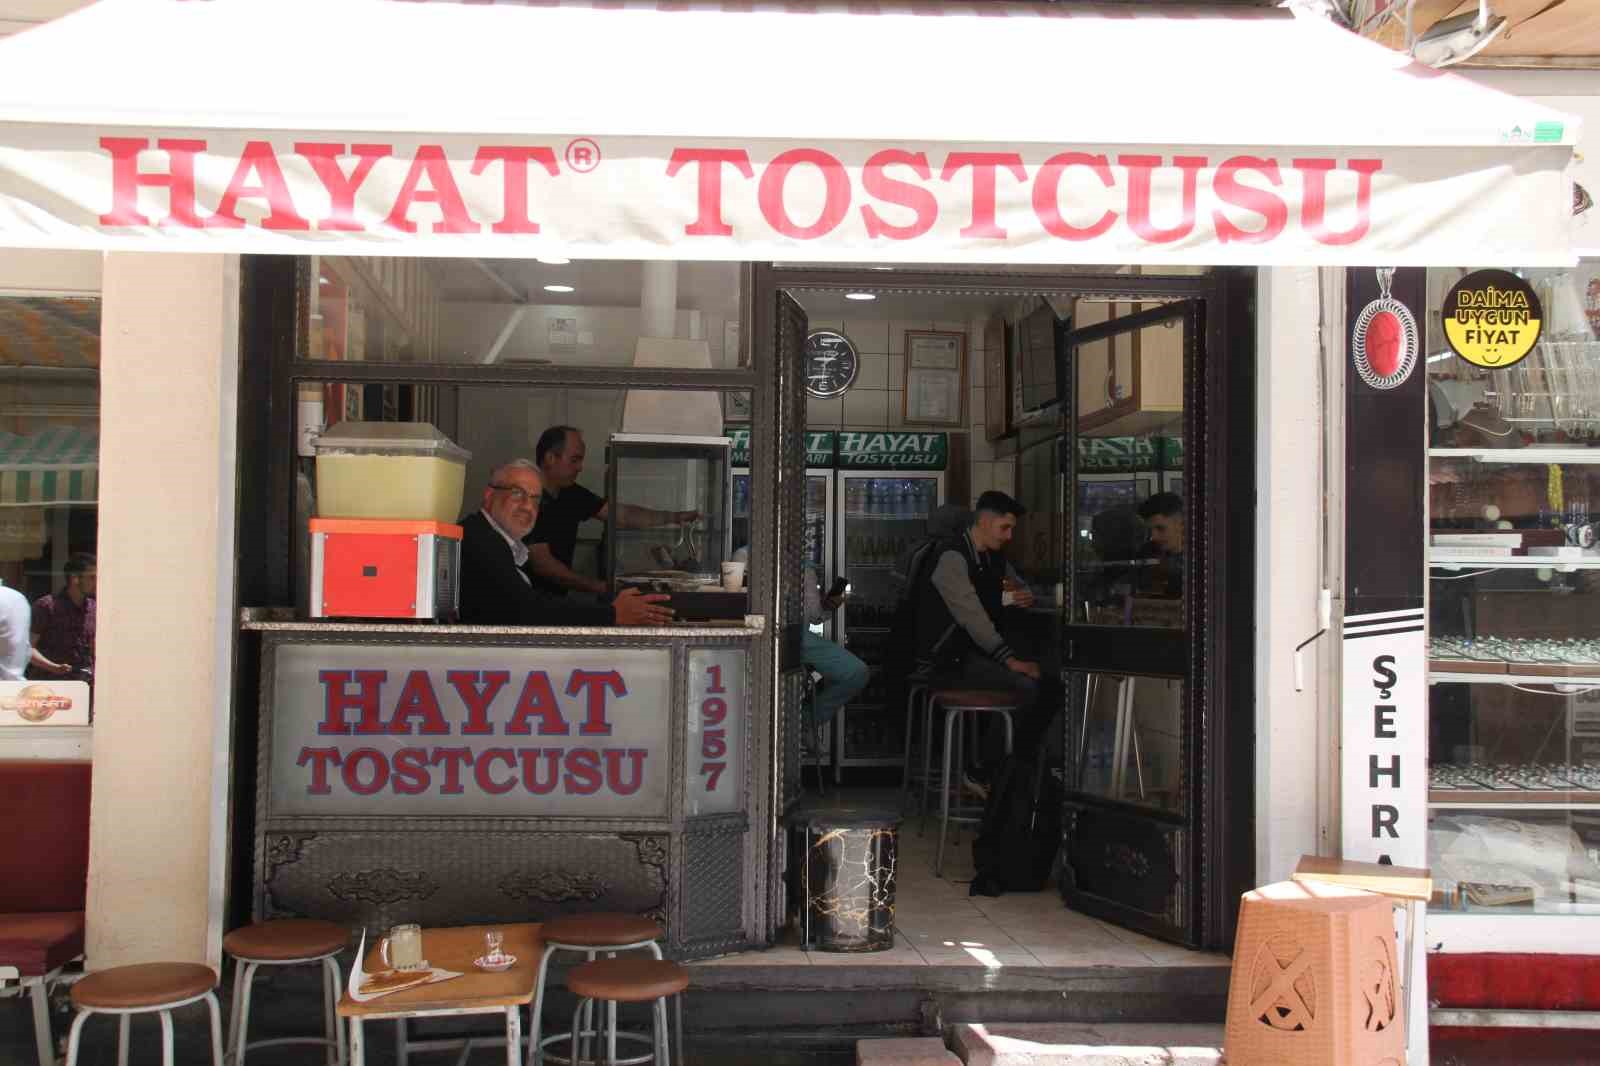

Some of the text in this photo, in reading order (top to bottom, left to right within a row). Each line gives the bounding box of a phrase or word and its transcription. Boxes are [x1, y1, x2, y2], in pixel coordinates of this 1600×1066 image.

[667, 147, 1384, 245] TOSTCUSU
[1457, 286, 1528, 307] DAİMA
[1455, 309, 1529, 326] UYGUN
[1465, 325, 1520, 344] FİYAT
[839, 432, 938, 452] HAYAT
[846, 453, 937, 465] TOSTCUSU
[317, 669, 628, 736] HAYAT
[699, 665, 728, 792] 1957
[296, 746, 648, 796] TOSTCUSU
